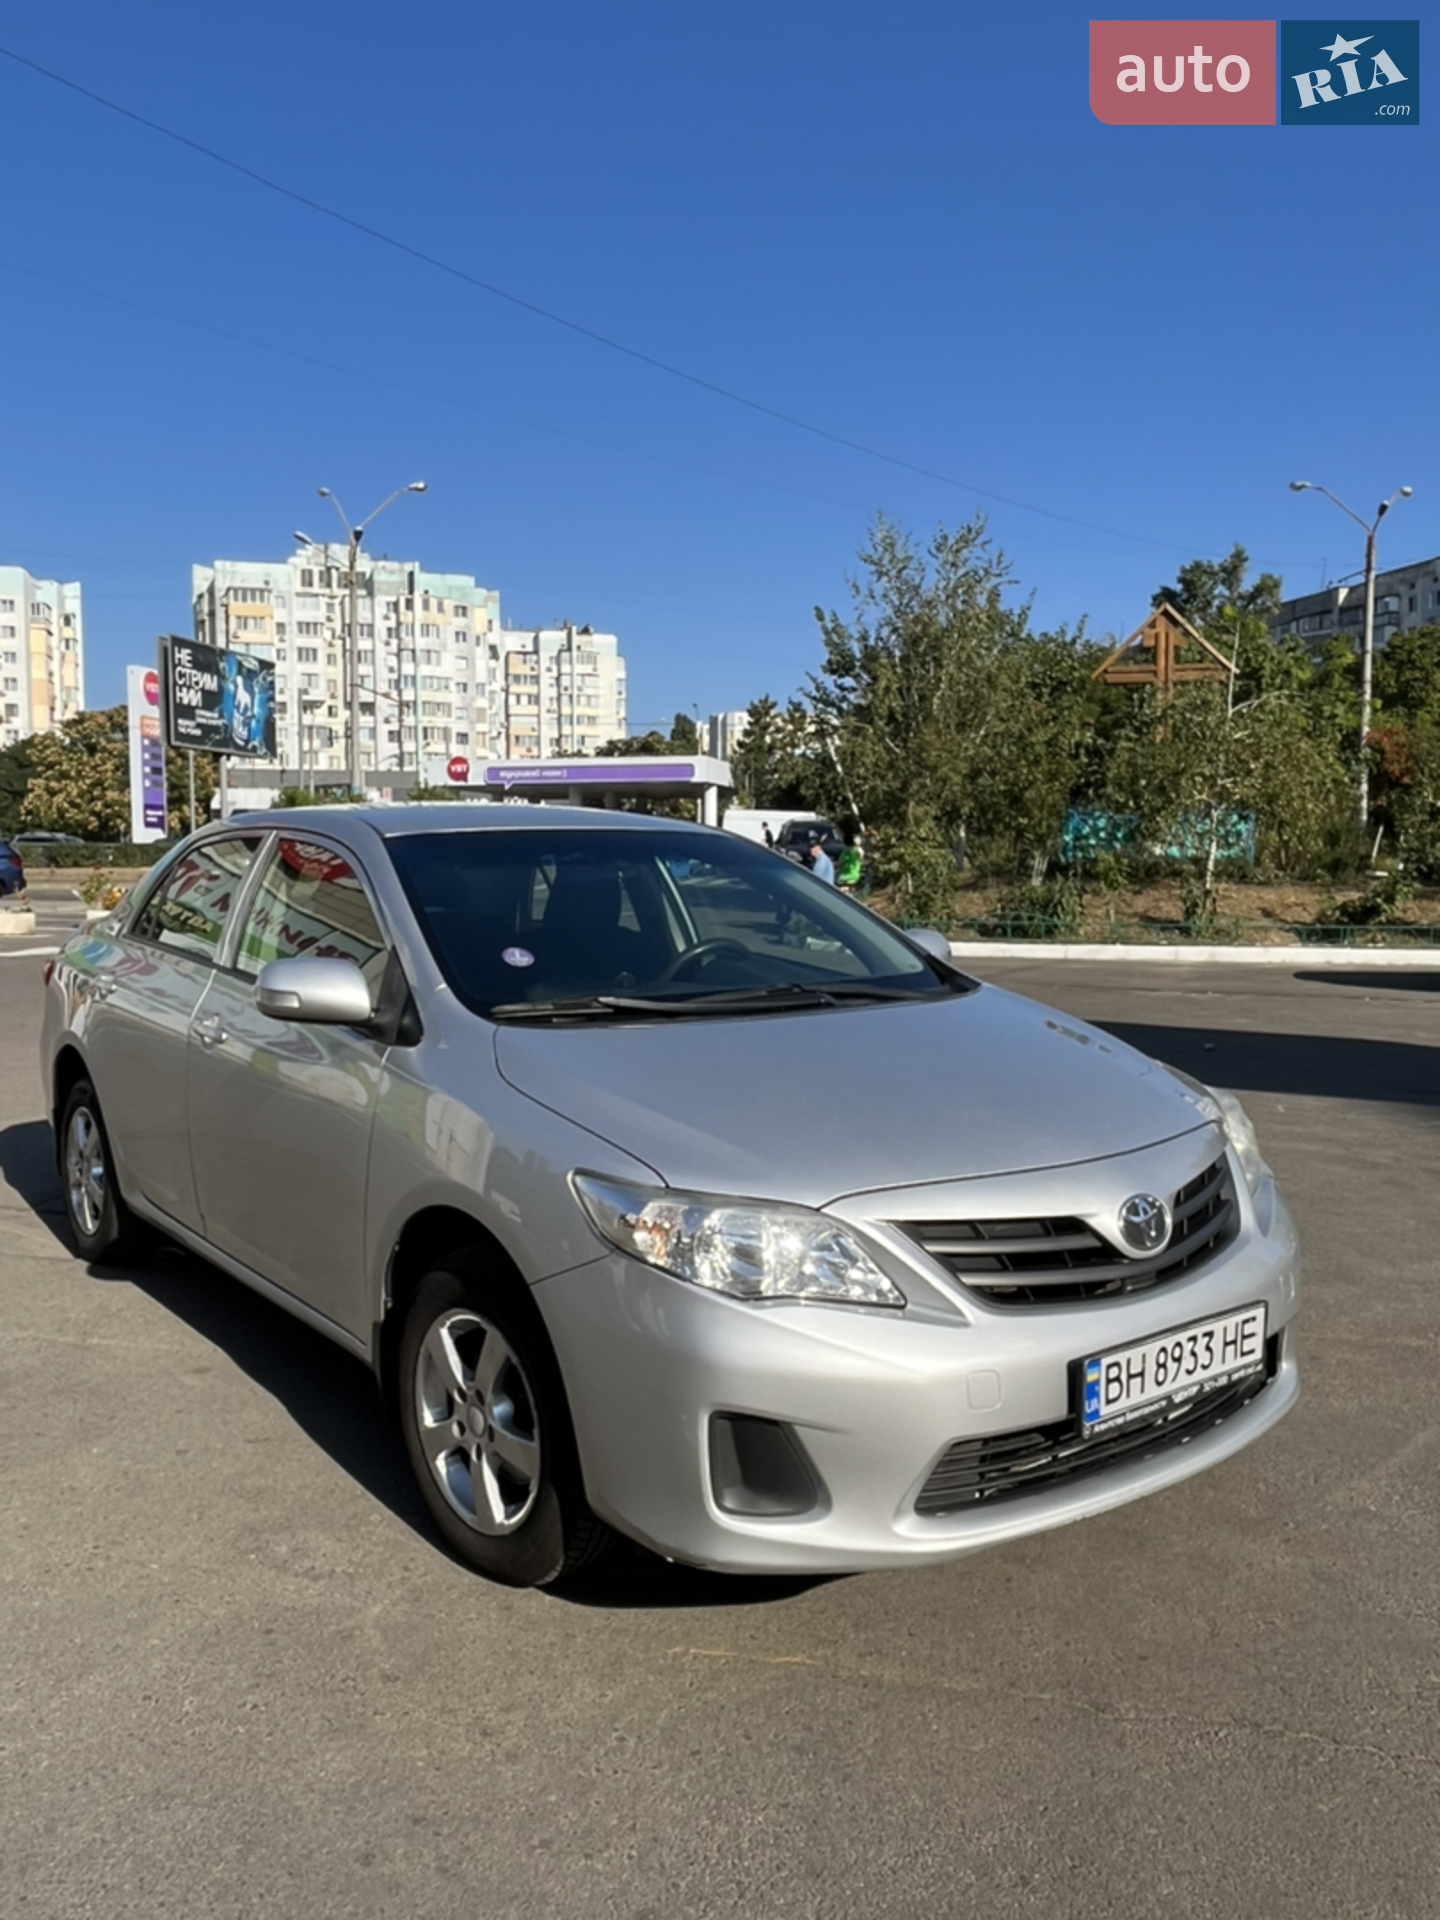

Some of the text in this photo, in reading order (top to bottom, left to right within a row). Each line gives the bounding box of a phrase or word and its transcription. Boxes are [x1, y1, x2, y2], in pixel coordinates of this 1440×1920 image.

[174, 646, 193, 668] НЕ
[175, 665, 218, 692] СТРИМ
[1105, 1316, 1258, 1406] BH 8933 HE
